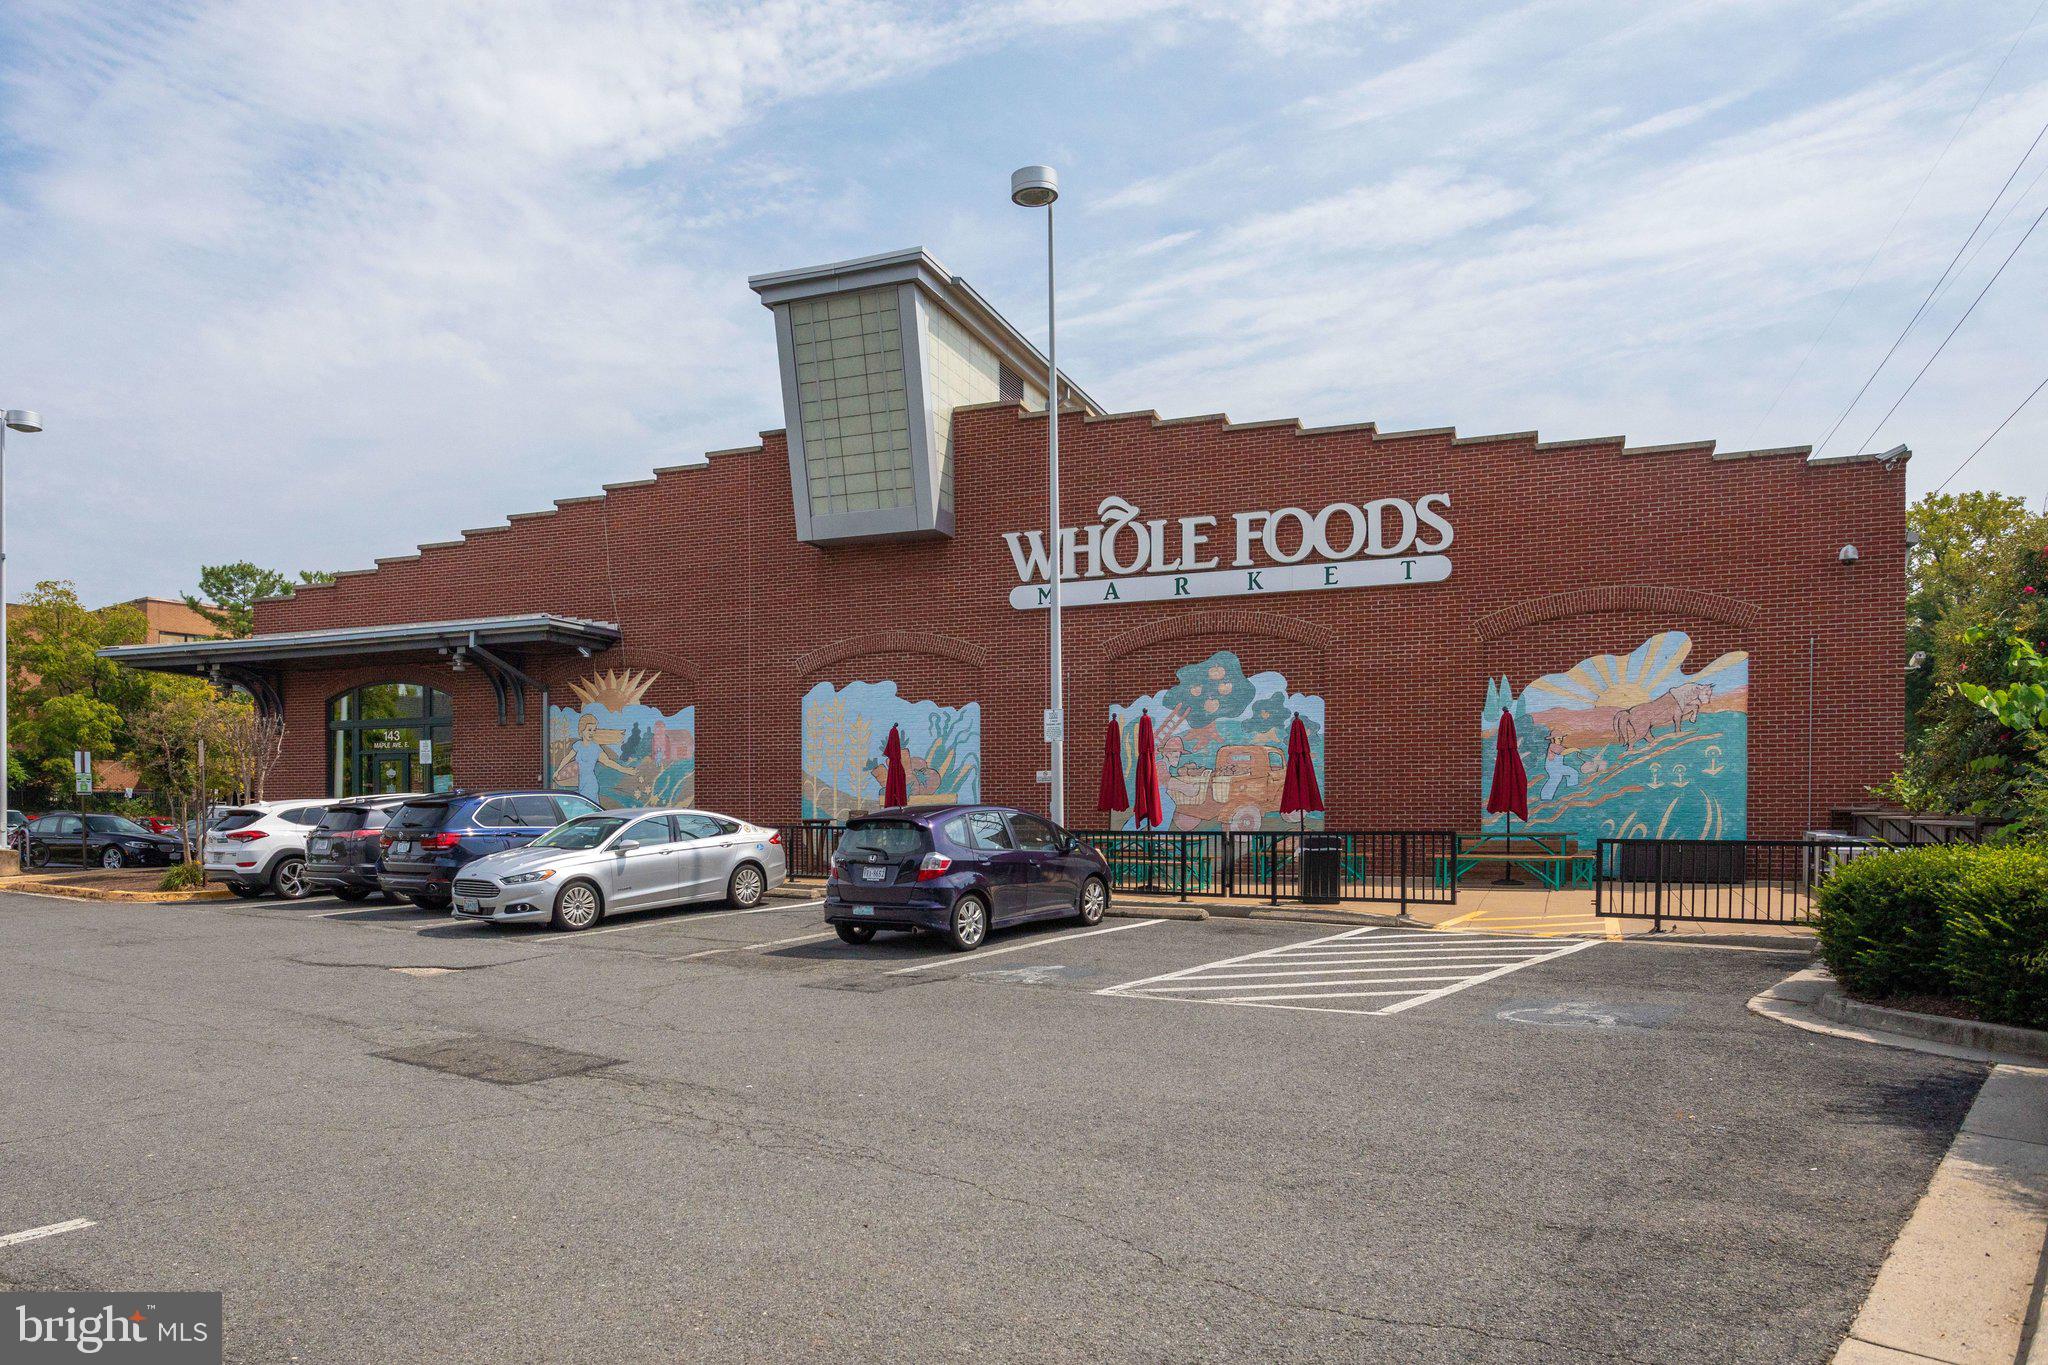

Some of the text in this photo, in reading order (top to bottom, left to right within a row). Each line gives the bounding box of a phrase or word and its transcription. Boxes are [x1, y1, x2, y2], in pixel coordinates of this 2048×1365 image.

[1002, 493, 1454, 582] WHOLE FOODS
[384, 730, 400, 741] 143
